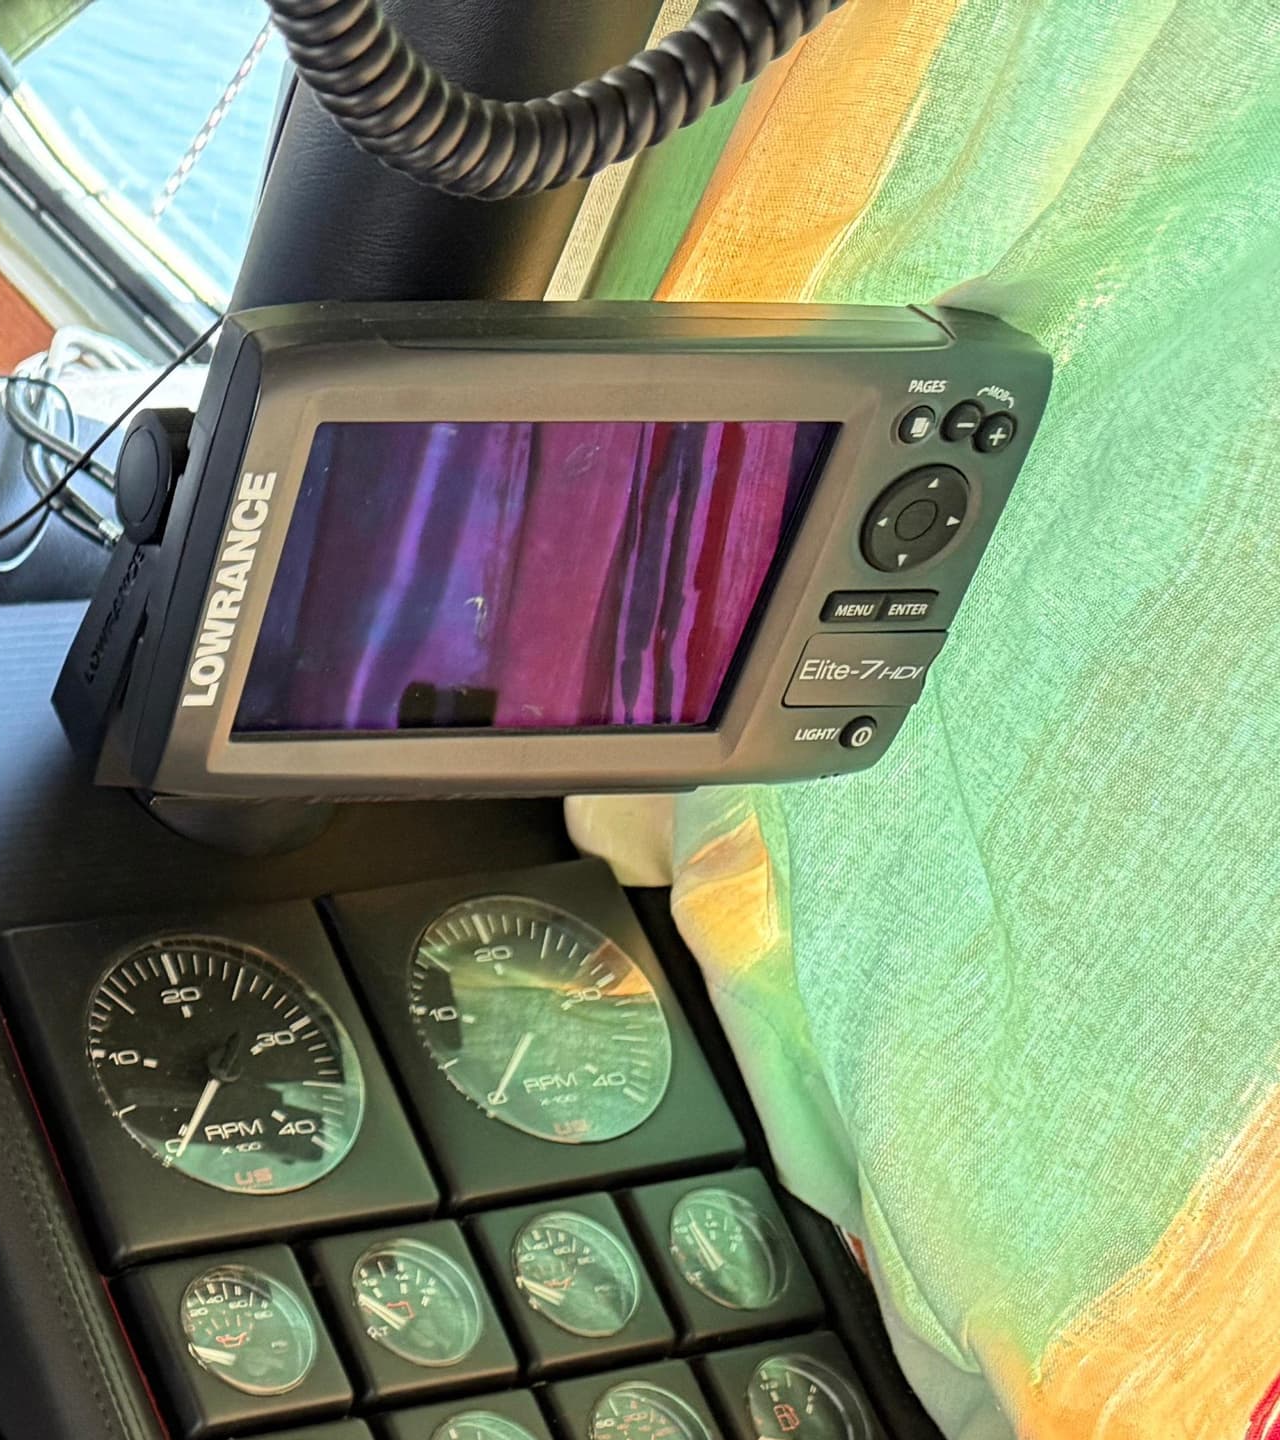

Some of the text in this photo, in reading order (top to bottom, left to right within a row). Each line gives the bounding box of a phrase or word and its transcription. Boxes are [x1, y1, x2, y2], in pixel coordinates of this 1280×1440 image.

[909, 380, 947, 393] PAGES
[987, 386, 1010, 401] MOB
[182, 472, 277, 707] LOWRANCE
[835, 603, 928, 616] MENU ENTER
[799, 660, 923, 681] Elite-7 HDI
[161, 987, 200, 1004] 20
[257, 1030, 295, 1048] 30
[109, 1051, 139, 1066] 10
[523, 1073, 578, 1093] RPM
[205, 1119, 263, 1141] RPM
[278, 1121, 316, 1135] 40
